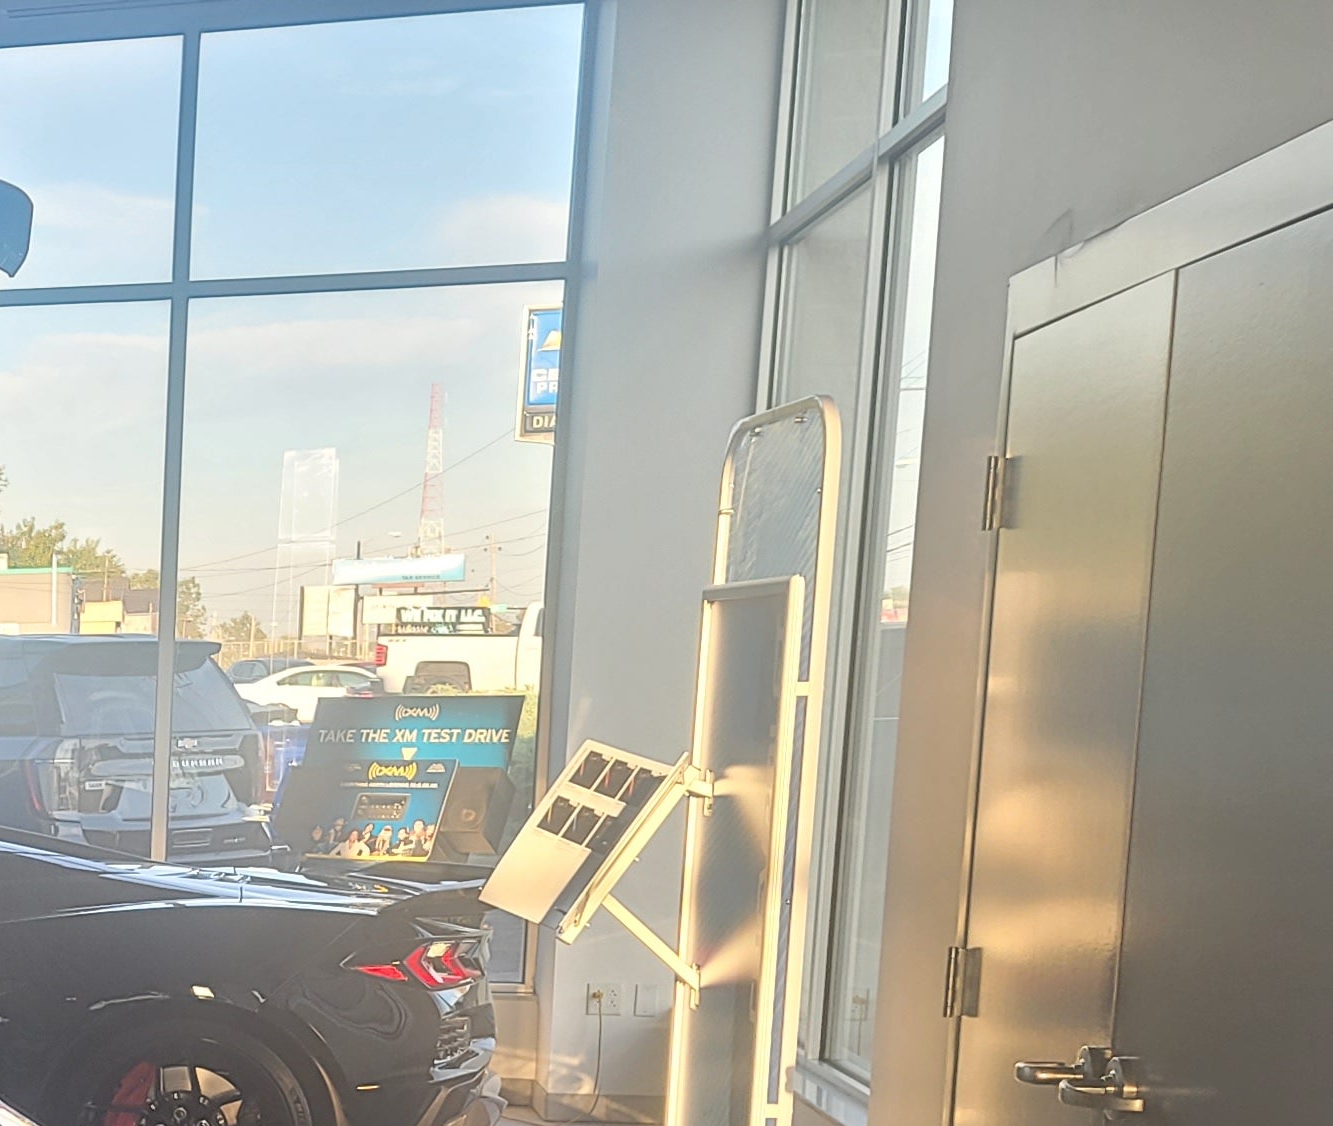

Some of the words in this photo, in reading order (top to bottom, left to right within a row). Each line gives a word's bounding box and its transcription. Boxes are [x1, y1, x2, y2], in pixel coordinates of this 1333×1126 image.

[318, 729, 357, 743] TAKE
[360, 729, 389, 743] THE
[393, 728, 418, 743] XM
[422, 728, 461, 743] TEST
[463, 728, 511, 743] DRIVE
